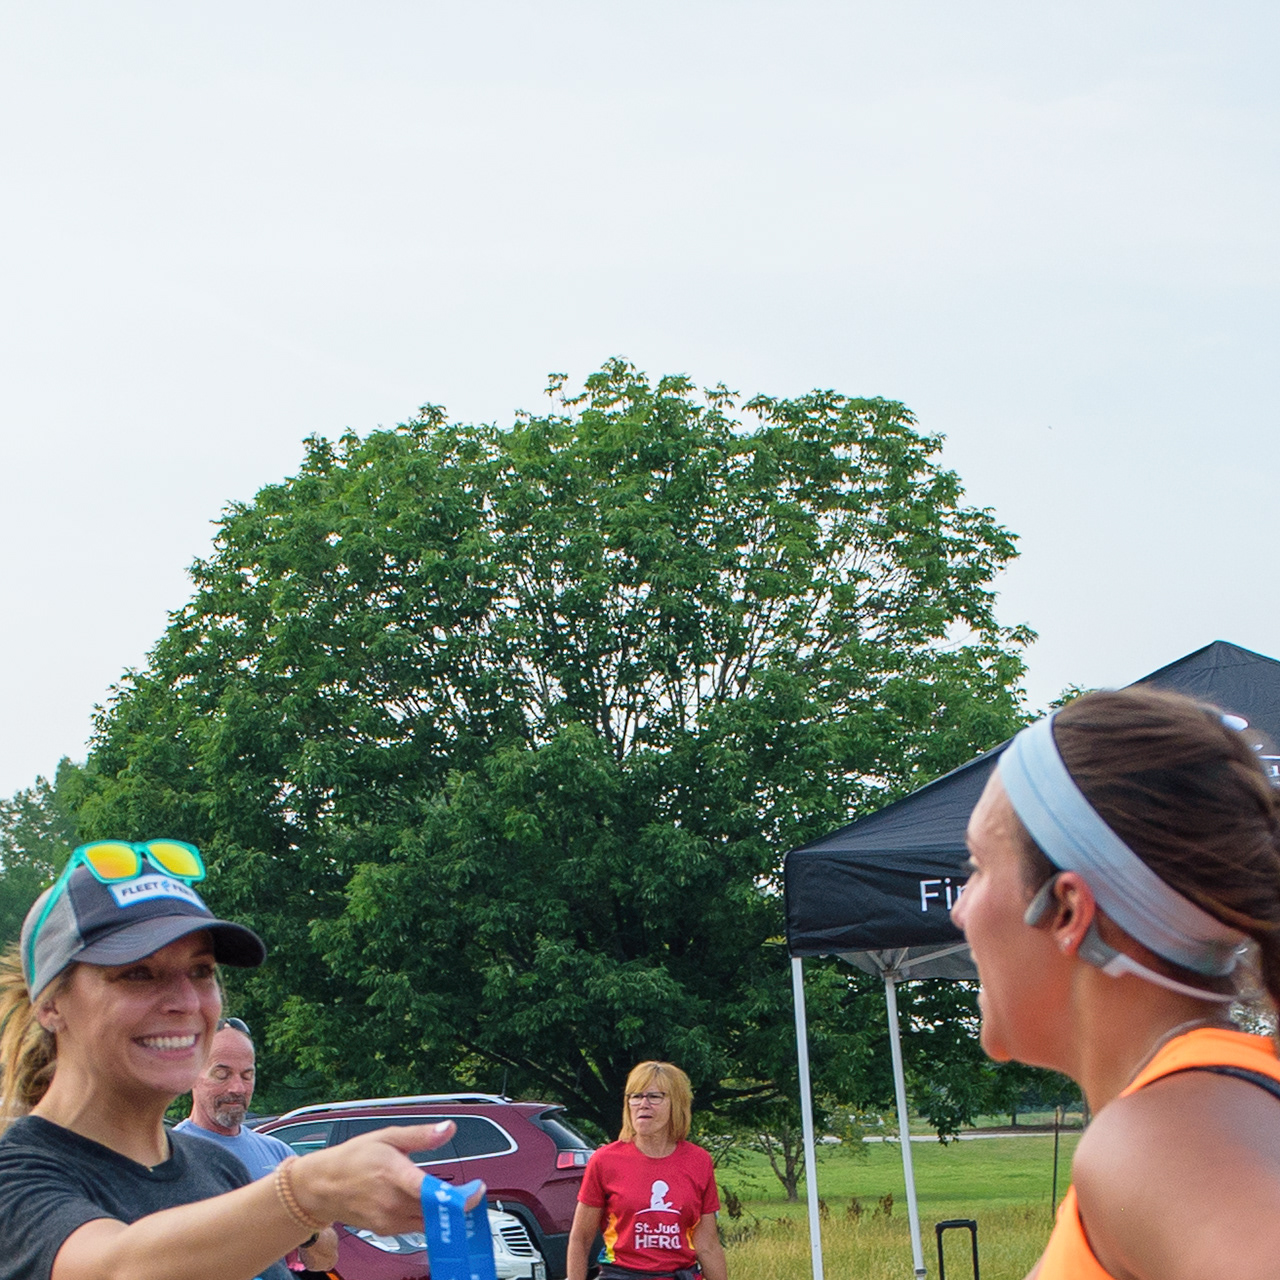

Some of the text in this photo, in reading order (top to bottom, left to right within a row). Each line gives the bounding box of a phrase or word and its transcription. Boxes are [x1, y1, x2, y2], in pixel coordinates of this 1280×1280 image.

[121, 882, 158, 897] FLEET
[635, 1222, 680, 1234] St. Jud
